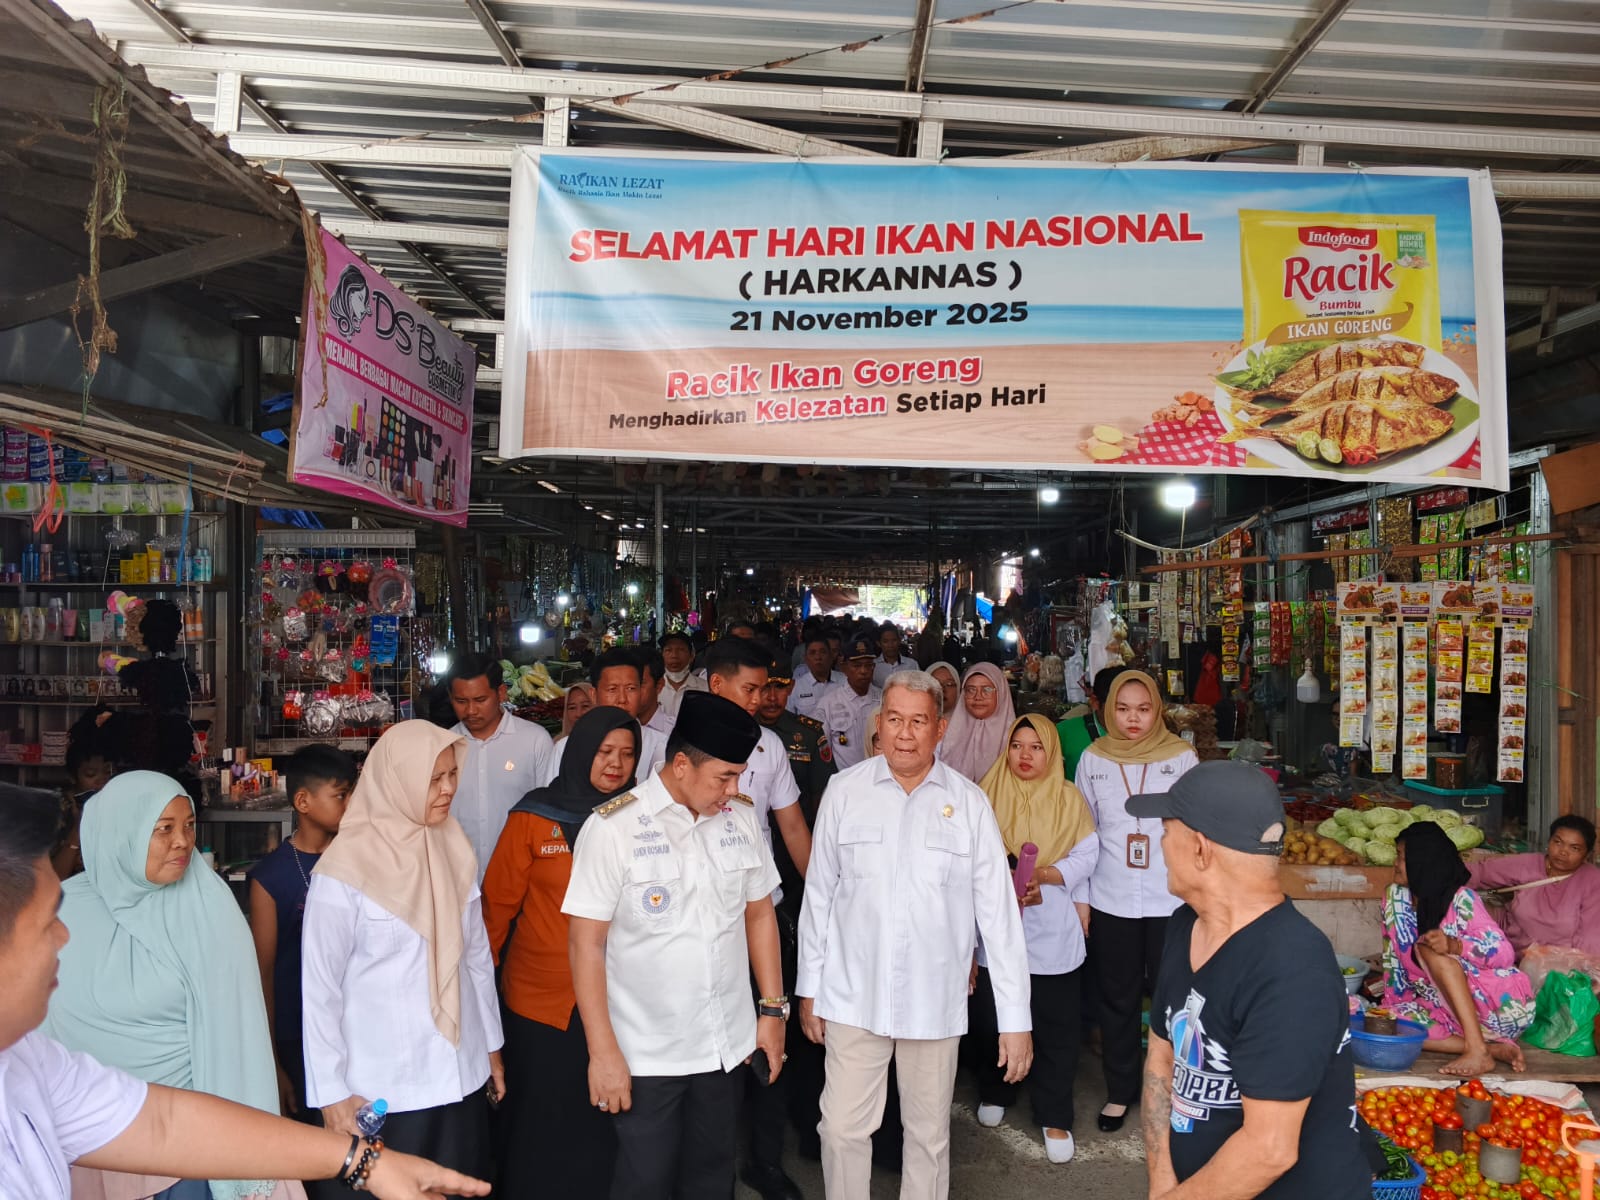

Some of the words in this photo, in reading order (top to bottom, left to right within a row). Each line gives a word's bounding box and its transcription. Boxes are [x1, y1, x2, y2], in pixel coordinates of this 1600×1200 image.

[560, 172, 618, 188] RACIKAN
[622, 177, 665, 190] LEZAT
[569, 229, 758, 263] SELAMAT
[766, 226, 865, 258] HARI
[875, 222, 975, 255] IKAN
[985, 212, 1203, 250] NASIONAL
[1307, 231, 1371, 249] Indofood
[764, 261, 997, 296] HARKANNAS
[1283, 253, 1395, 301] Racik
[730, 311, 762, 331] 21
[772, 305, 937, 330] November
[946, 301, 1028, 325] 2025
[1320, 300, 1361, 310] Bumbu
[372, 291, 415, 355] DS
[417, 323, 464, 402] Beauty
[1287, 321, 1329, 339] IKAN
[1334, 317, 1392, 335] GORENG
[326, 337, 359, 373] MENJUAL
[360, 357, 390, 390] BERBAGAI
[390, 375, 412, 402] MACAM
[665, 363, 762, 399] Racik
[768, 360, 844, 392] Ikan
[853, 355, 983, 386] Goreng
[609, 409, 746, 429] Menghadirkan
[755, 394, 888, 424] Kelezatan
[896, 389, 982, 413] Setiap
[991, 383, 1046, 407] Hari
